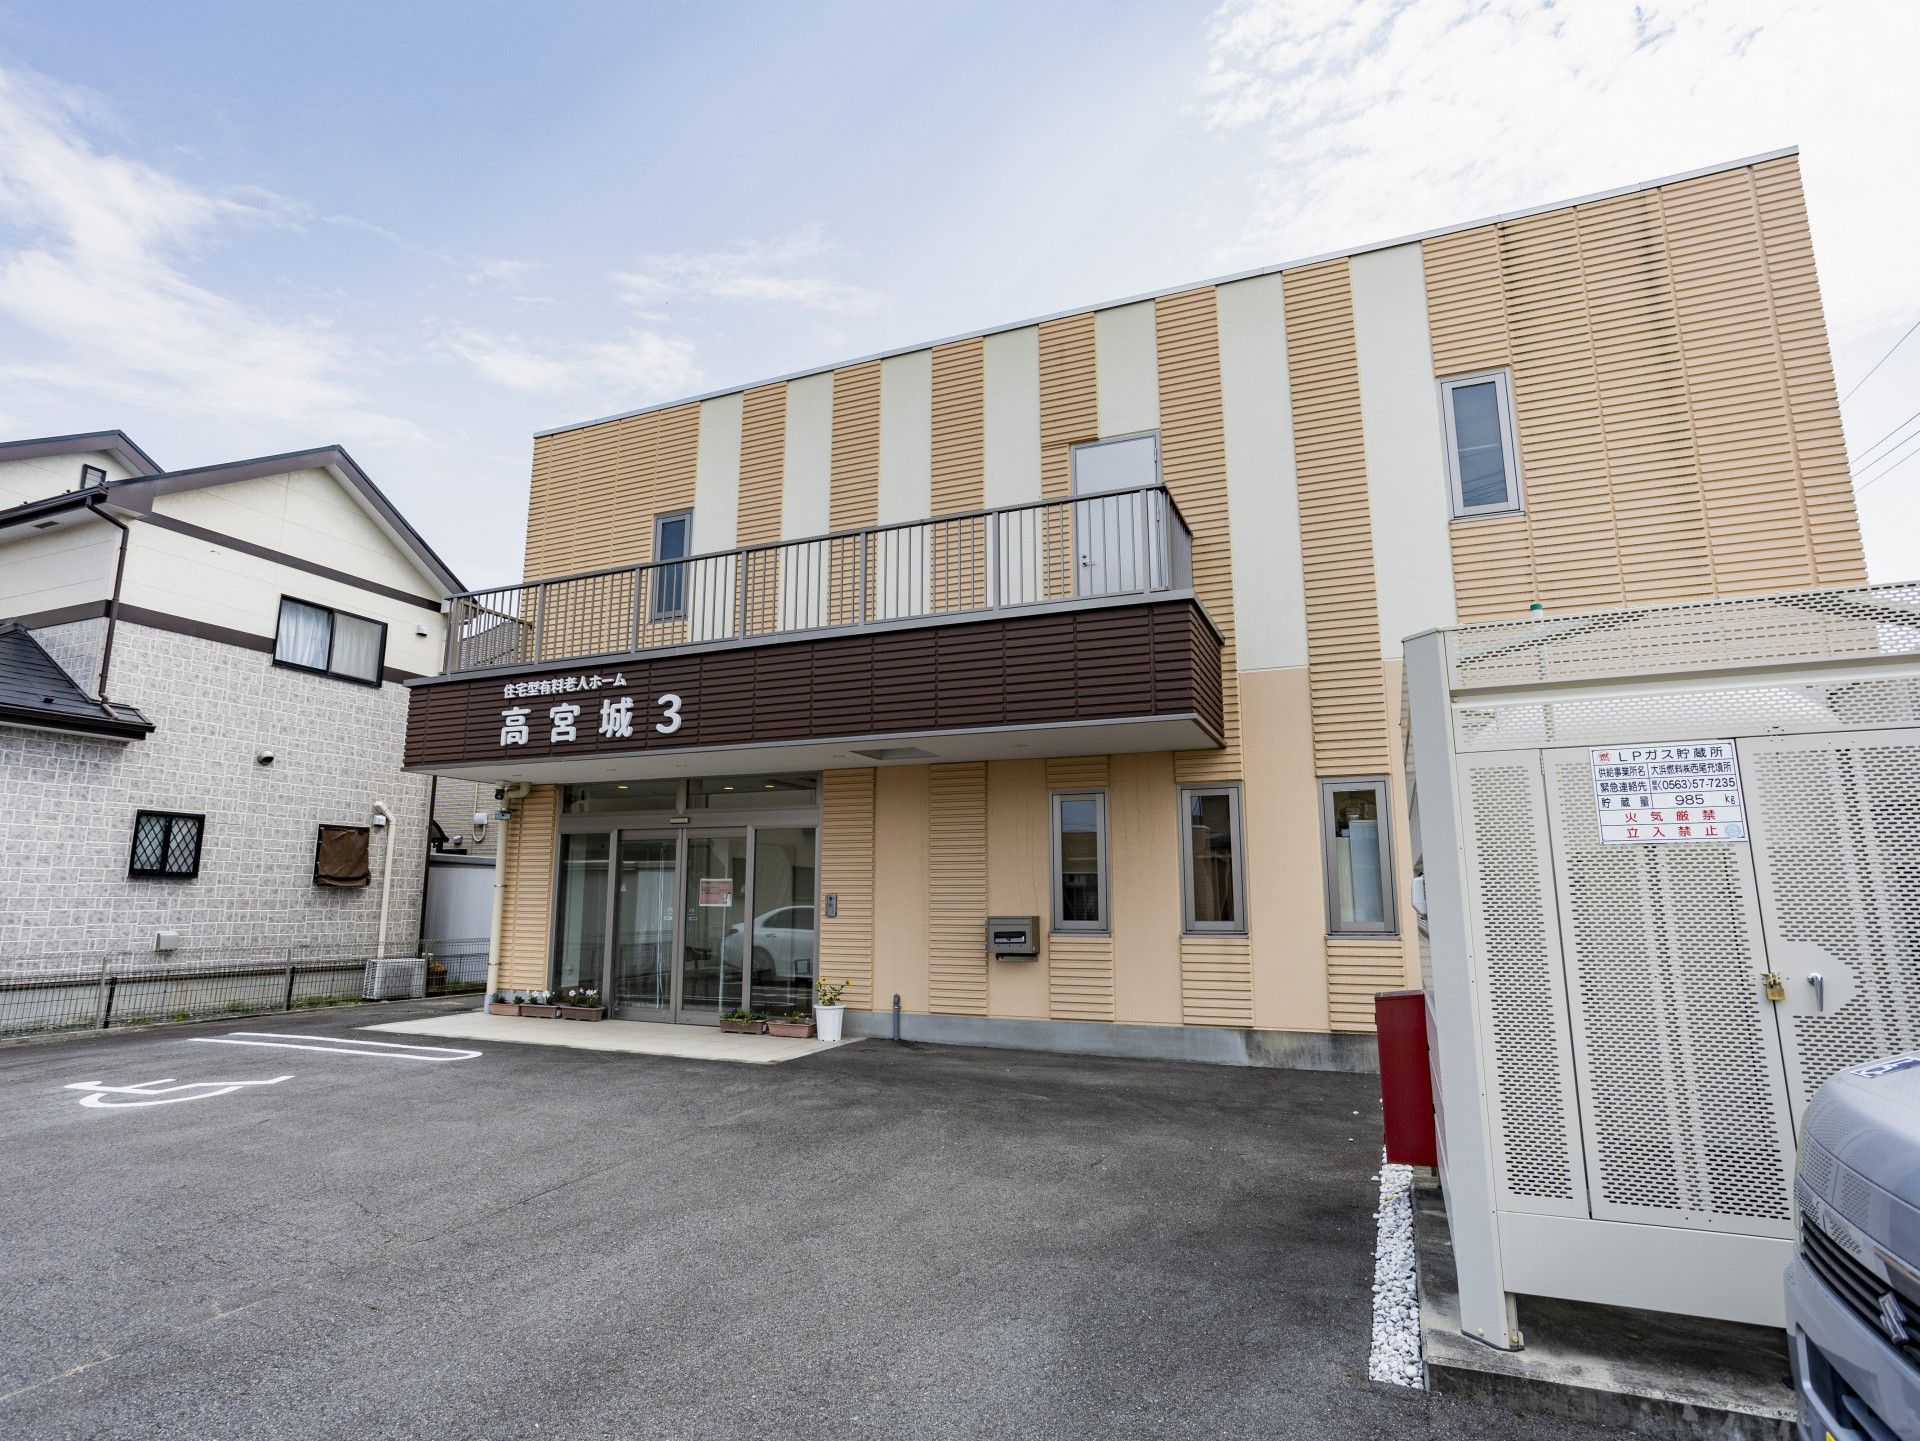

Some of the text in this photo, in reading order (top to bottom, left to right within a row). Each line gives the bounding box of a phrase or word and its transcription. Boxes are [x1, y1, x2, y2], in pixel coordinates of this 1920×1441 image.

[503, 672, 627, 699] 住宅型有料老人ホーム
[1598, 765, 1646, 778] 供給事業所名
[1600, 781, 1647, 793] 緊急連絡先
[1675, 793, 1736, 805] 985 kg
